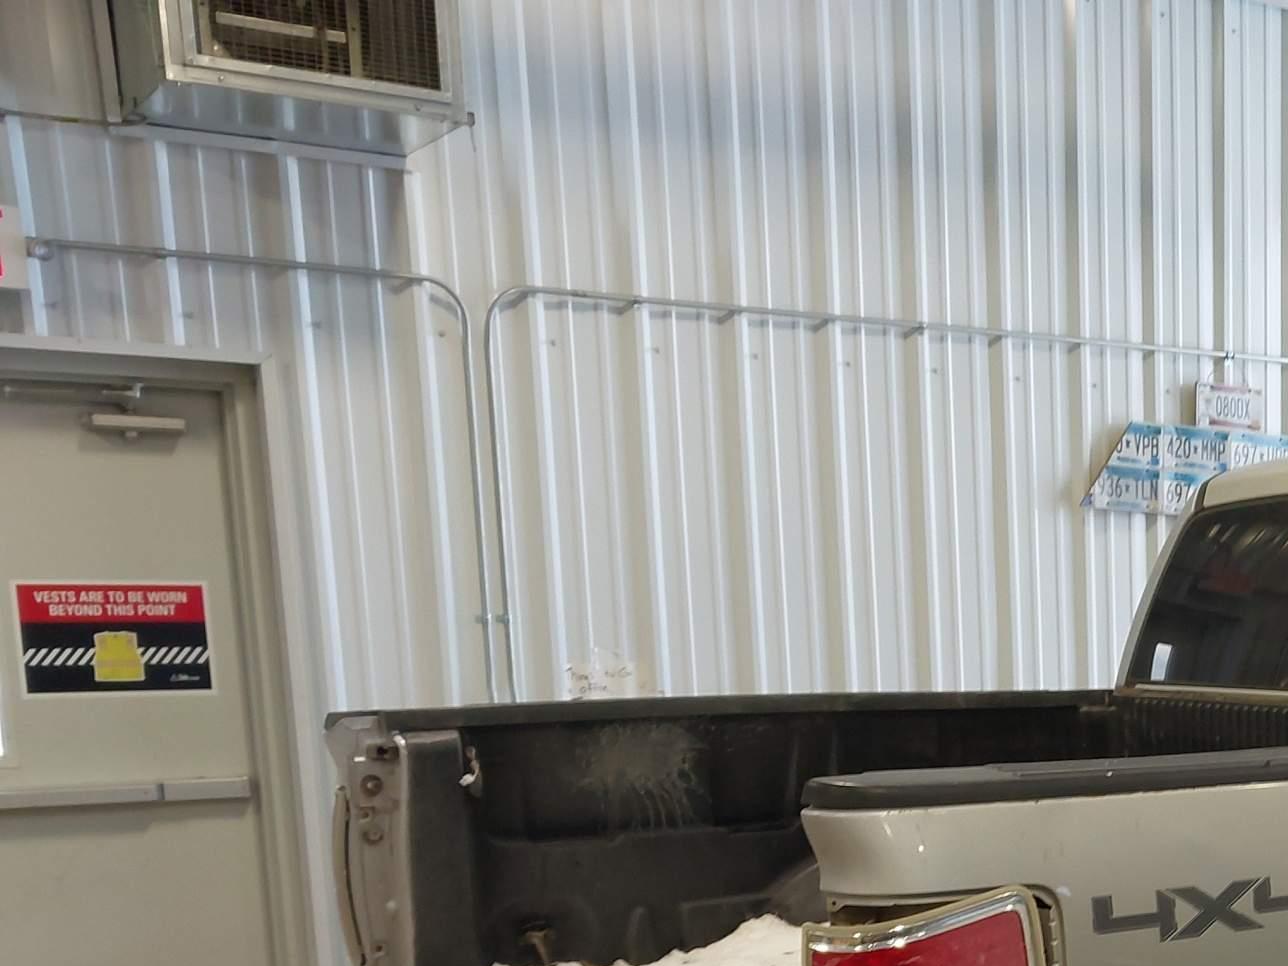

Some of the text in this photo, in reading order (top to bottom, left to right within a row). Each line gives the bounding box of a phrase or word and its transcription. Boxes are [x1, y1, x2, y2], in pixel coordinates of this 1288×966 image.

[33, 591, 188, 604] VESTS ARE TO BE WORN
[49, 604, 176, 616] BEYOND THIS POINT
